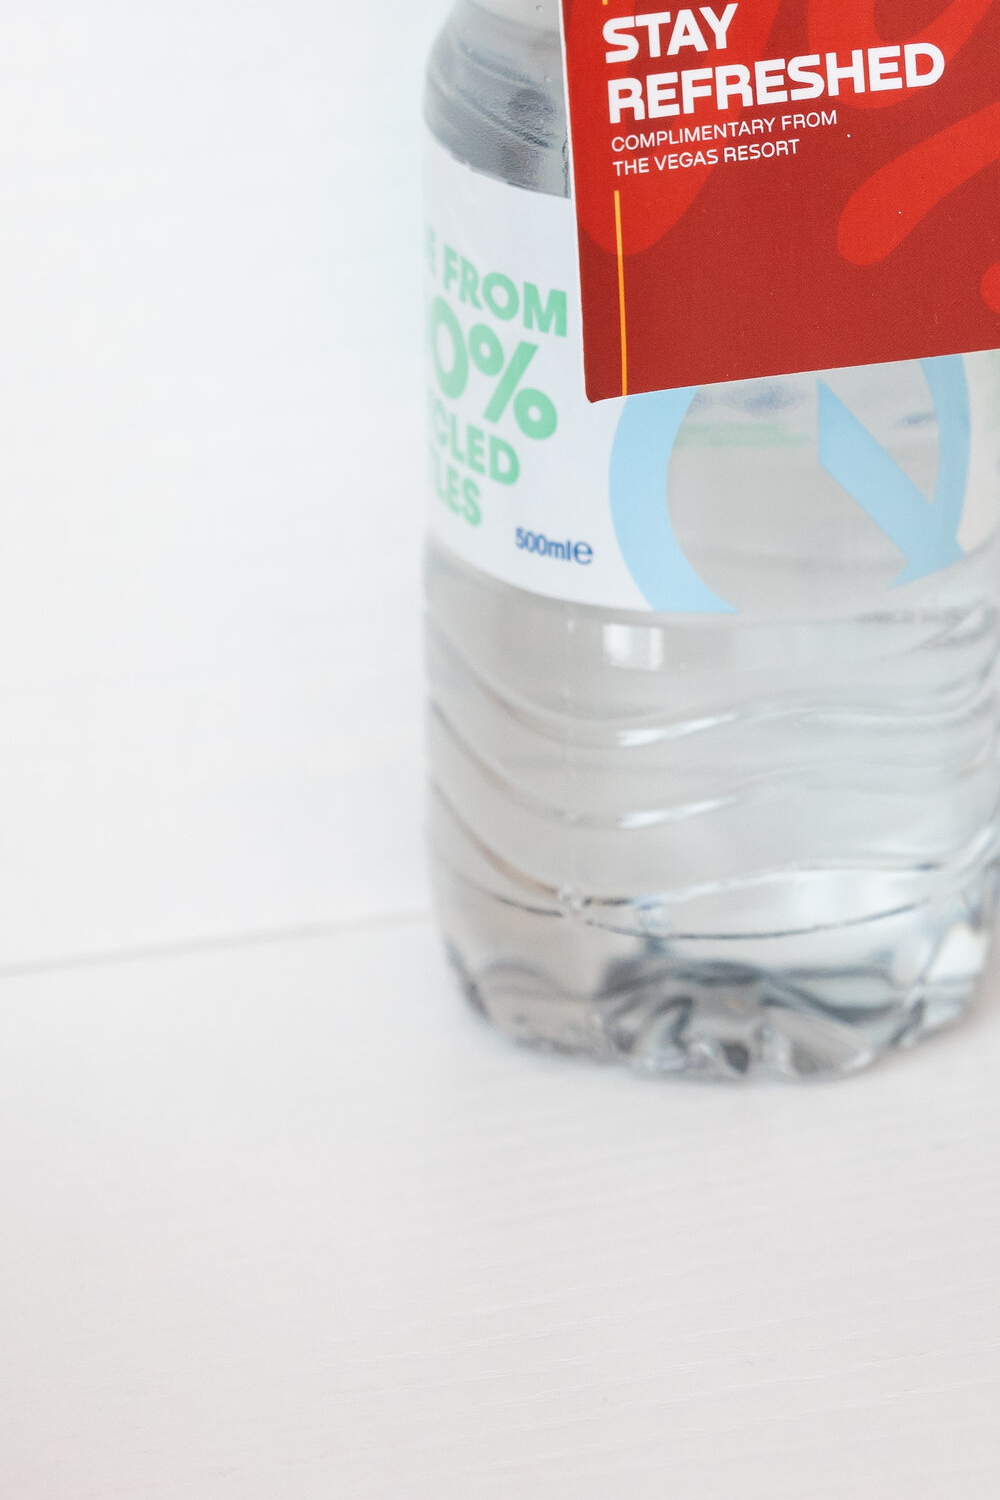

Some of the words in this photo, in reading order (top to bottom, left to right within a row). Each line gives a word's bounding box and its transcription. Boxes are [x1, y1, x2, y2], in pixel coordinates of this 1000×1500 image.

[602, 3, 739, 63] STAY
[607, 42, 946, 124] REFRESHED
[611, 116, 776, 152] COMPLIMENTARY
[781, 110, 838, 132] FROM
[612, 159, 650, 177] THE
[653, 149, 719, 171] VEGAS
[723, 139, 800, 162] RESORT
[443, 243, 568, 338] FROM
